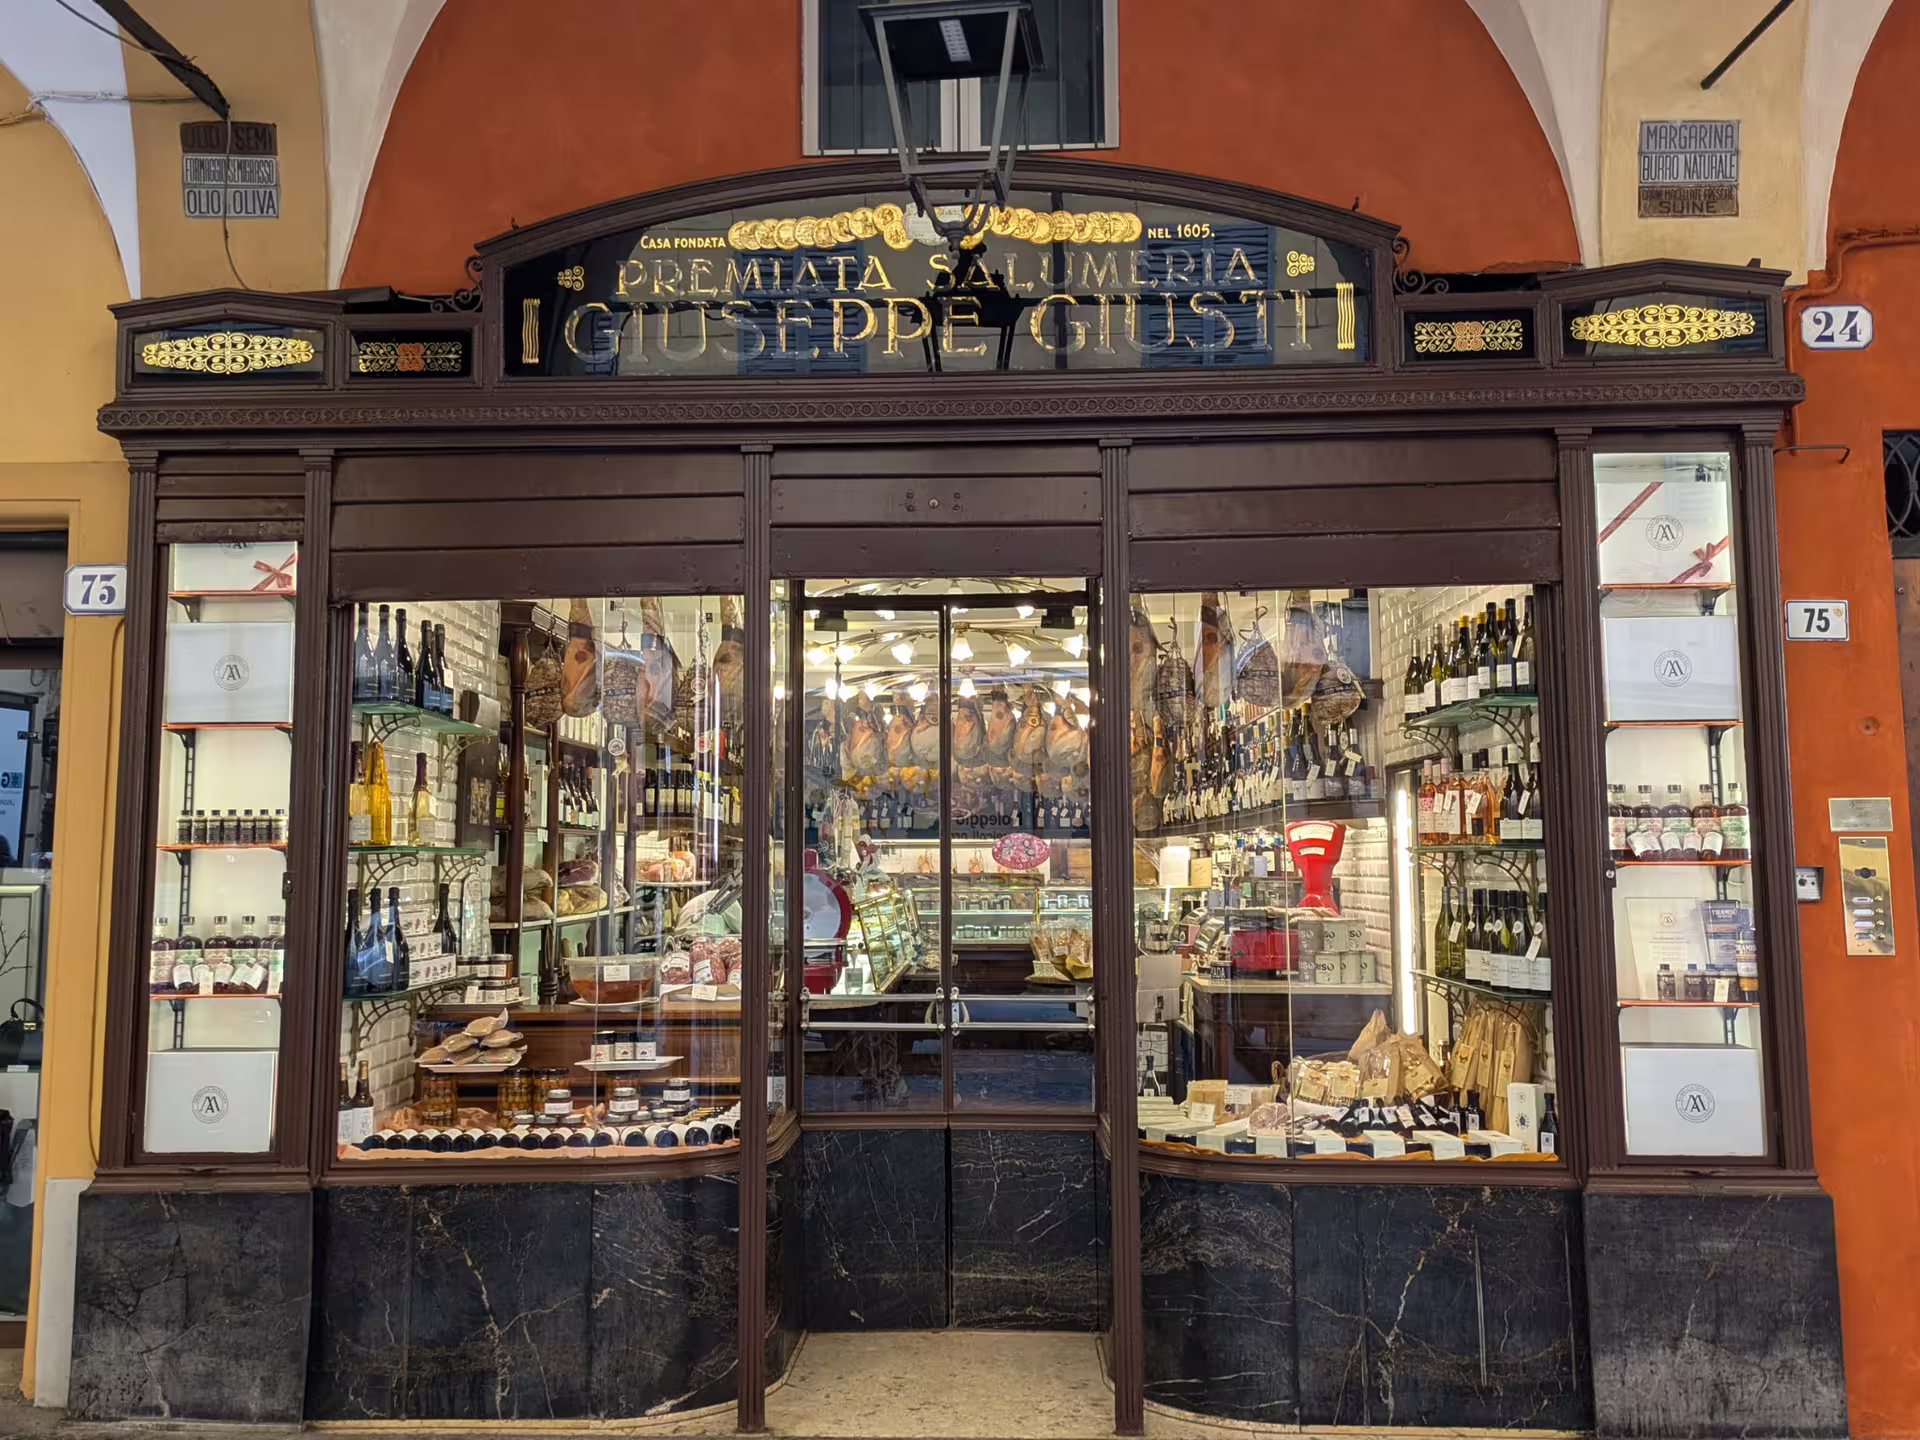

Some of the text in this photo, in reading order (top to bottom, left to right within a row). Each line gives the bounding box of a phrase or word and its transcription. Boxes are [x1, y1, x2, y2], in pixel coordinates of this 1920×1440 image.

[234, 126, 274, 151] SEMI
[1645, 123, 1735, 150] MARGARINA
[1642, 153, 1736, 181] BURRO NATURALE
[186, 189, 221, 214] OLIO
[232, 189, 277, 215] OLIVA
[1658, 200, 1718, 214] SUINE
[640, 234, 727, 249] CASA FONDATA
[1147, 223, 1216, 240] NEL 1605.
[615, 246, 1264, 299] PREMIATA SALUMERIA
[564, 288, 1313, 363] GIUSEPPE GIUSTI
[1812, 310, 1863, 343] 24
[80, 573, 118, 606] 75
[1802, 607, 1831, 633] 75
